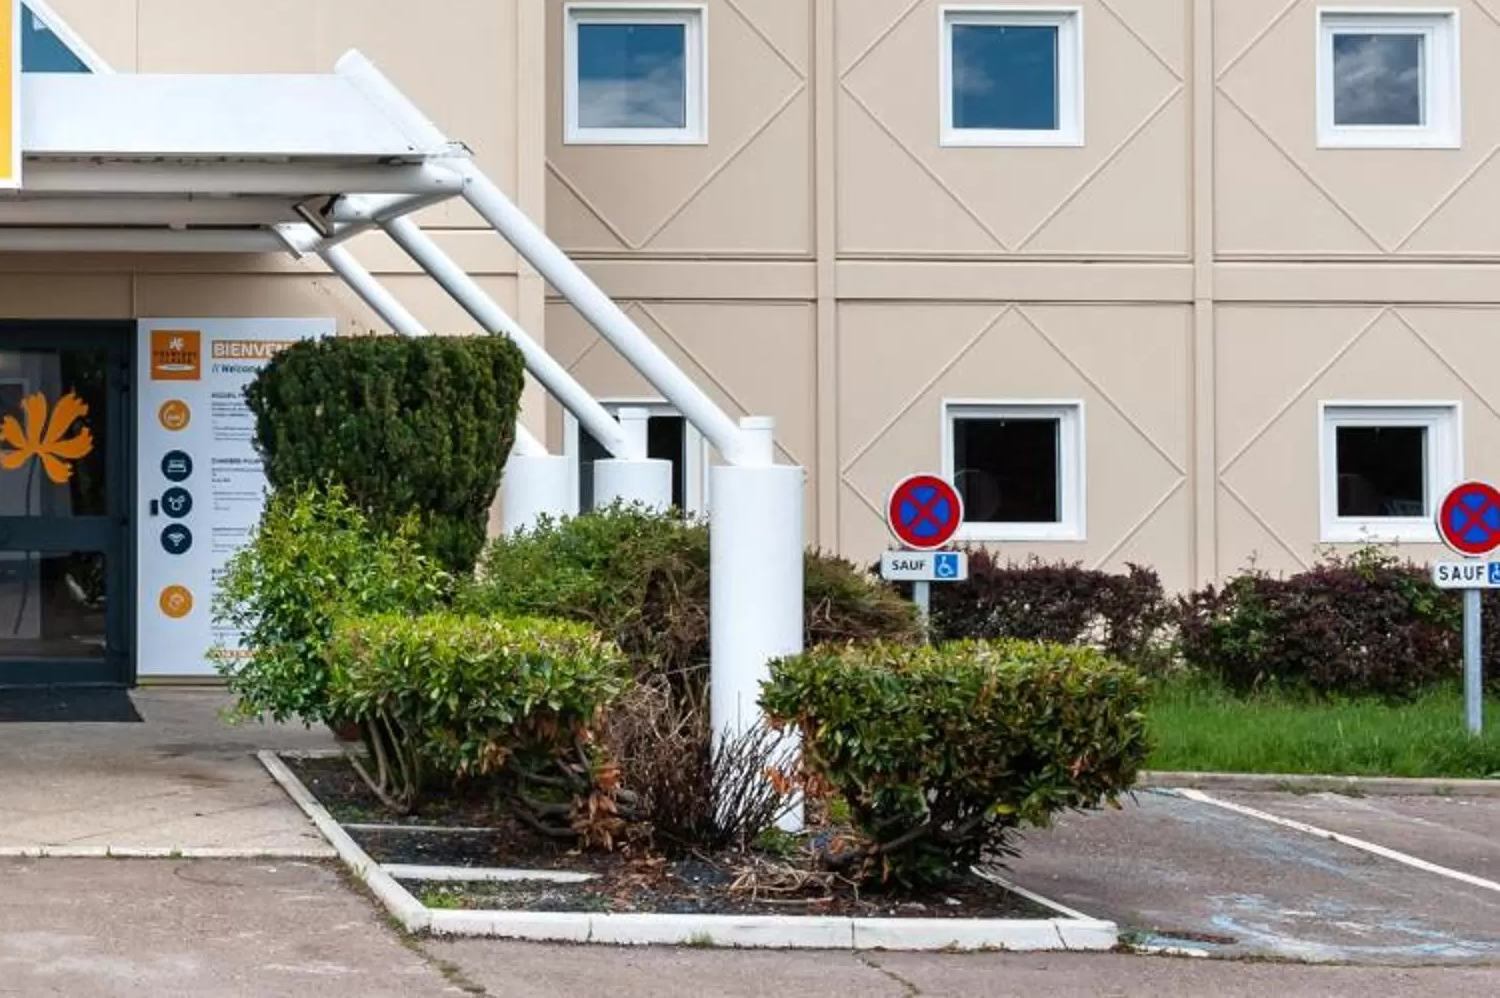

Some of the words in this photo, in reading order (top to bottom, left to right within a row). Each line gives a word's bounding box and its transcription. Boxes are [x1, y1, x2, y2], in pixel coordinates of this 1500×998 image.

[213, 342, 292, 358] BIENVE
[891, 559, 926, 571] SAUF
[1438, 565, 1485, 581] SAUF
